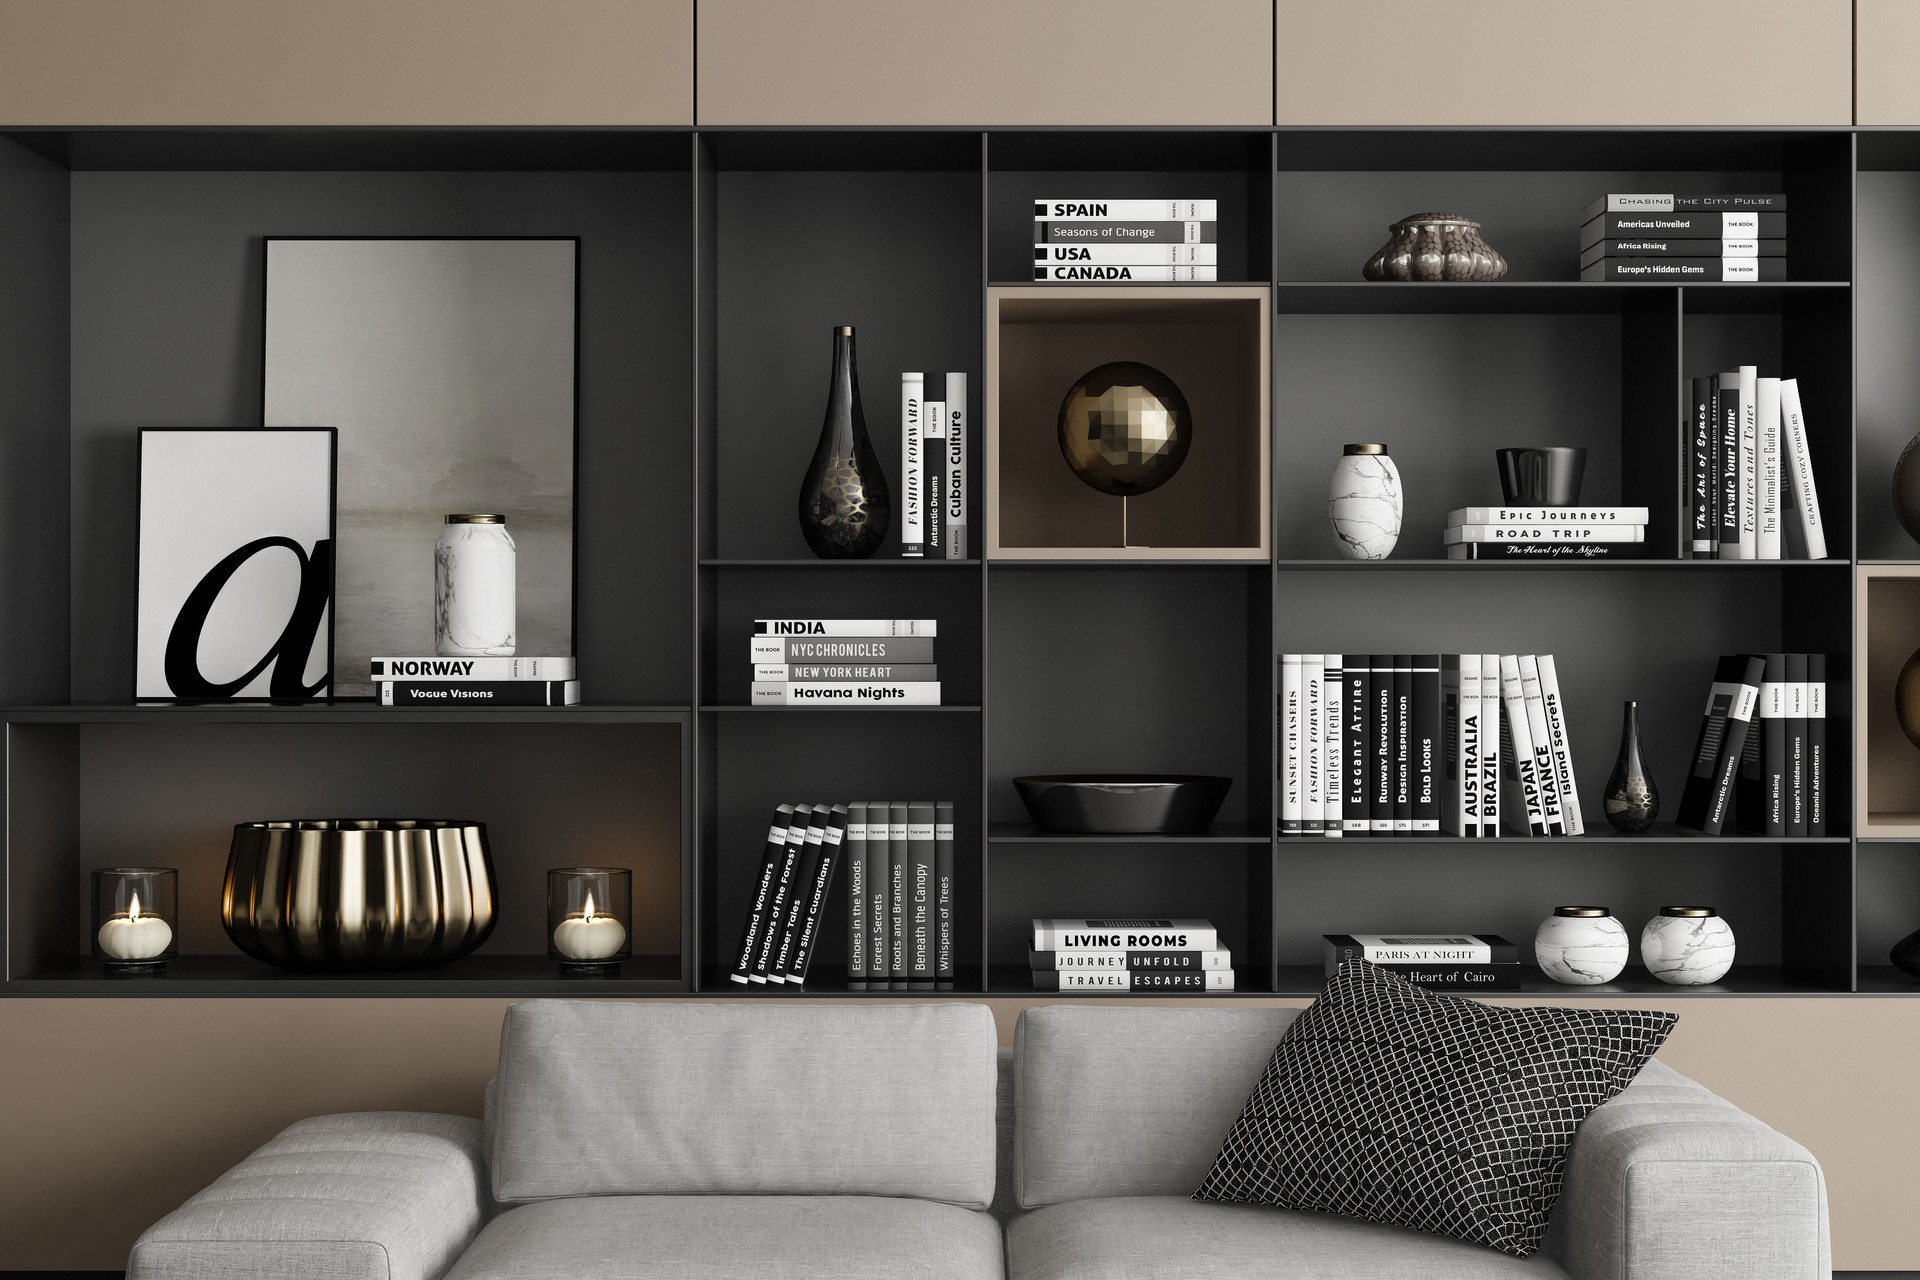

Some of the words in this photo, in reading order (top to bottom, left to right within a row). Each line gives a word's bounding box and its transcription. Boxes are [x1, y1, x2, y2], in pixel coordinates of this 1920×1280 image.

[1054, 203, 1107, 217] SPAIN
[1617, 220, 1654, 228] Americas
[1655, 220, 1690, 228] Unveiled
[1054, 227, 1098, 236] Seasons
[1101, 227, 1112, 236] of
[1116, 227, 1155, 238] Change
[1642, 242, 1667, 250] Rising
[1054, 247, 1092, 260] USA
[1054, 267, 1132, 280] CANADA
[1617, 265, 1652, 275] Europe's
[1652, 265, 1680, 273] Hidden
[908, 398, 917, 463] FORWARD
[949, 410, 961, 465] Culture
[1696, 403, 1707, 447] Space
[1724, 408, 1735, 446] Home
[1743, 404, 1753, 440] Tones
[1791, 413, 1803, 454] CORNERS
[1763, 427, 1775, 453] Guide
[1697, 452, 1707, 467] of
[1724, 447, 1735, 477] Your
[1743, 446, 1753, 473] and
[1797, 455, 1808, 479] COZY
[908, 468, 917, 525] FASHION
[949, 469, 961, 518] Cuban
[1696, 473, 1706, 498] Art
[1763, 457, 1775, 514] Minimalist's
[1696, 504, 1706, 529] The
[1724, 480, 1735, 527] Elevate
[1743, 477, 1753, 533] Textures
[1803, 481, 1816, 525] CRAFTING
[930, 508, 938, 547] Antarctic
[1496, 529, 1541, 538] ROAD
[1552, 529, 1591, 538] TRIP
[1763, 517, 1775, 534] The
[1506, 545, 1522, 554] The
[1524, 545, 1552, 554] Heart
[1552, 546, 1562, 557] of
[1575, 545, 1608, 557] Skyline
[164, 536, 329, 698] a
[774, 621, 826, 634] INDIA
[791, 643, 814, 656] NYC
[816, 643, 885, 656] CHRONICLES
[391, 661, 474, 676] NORWAY
[795, 667, 820, 677] NEW
[822, 667, 852, 677] YORK
[855, 667, 892, 677] HEART
[794, 688, 852, 698] Havana
[857, 686, 905, 700] Nights
[1326, 700, 1339, 743] Trends
[1546, 693, 1563, 747] Secrets
[1326, 749, 1339, 804] Timeless
[1464, 715, 1477, 817] AUSTRALIA
[1535, 744, 1560, 816] FRANCE
[1555, 750, 1572, 795] Island
[1483, 752, 1496, 816] BRAZIL
[1520, 759, 1542, 816] JAPAN
[1712, 786, 1727, 823] Antarctic
[1722, 755, 1735, 785] Dreams
[1772, 774, 1780, 798] Rising
[780, 848, 796, 884] Forest
[852, 860, 861, 895] Woods
[775, 886, 786, 904] the
[892, 864, 902, 913] Branches
[914, 863, 928, 902] Canopy
[939, 876, 948, 904] Trees
[739, 914, 760, 970] Woodland
[754, 863, 773, 911] Wonders
[772, 906, 780, 918] of
[794, 950, 805, 970] The
[800, 916, 814, 948] Silent
[809, 857, 830, 914] Guardians
[852, 898, 861, 916] the
[873, 894, 882, 933] Secrets
[915, 905, 926, 923] the
[939, 907, 948, 918] of
[775, 930, 792, 970] Timber
[787, 900, 800, 927] Tales
[851, 919, 861, 929] in
[892, 917, 901, 937] and
[757, 921, 776, 970] Shadows
[852, 932, 861, 970] Echoes
[873, 936, 882, 970] Forest
[892, 940, 901, 970] Roots
[914, 926, 926, 970] Beneath
[939, 921, 950, 971] Whispers
[1065, 935, 1120, 947] LIVING
[1127, 934, 1187, 947] ROOMS
[1059, 957, 1124, 966] JOURNEY
[1133, 957, 1189, 966] UNFOLD
[1409, 971, 1442, 982] Heart
[1446, 971, 1459, 982] of
[1464, 971, 1495, 982] Cairo
[1068, 976, 1123, 985] TRAVEL
[1134, 976, 1200, 985] ESCAPES
